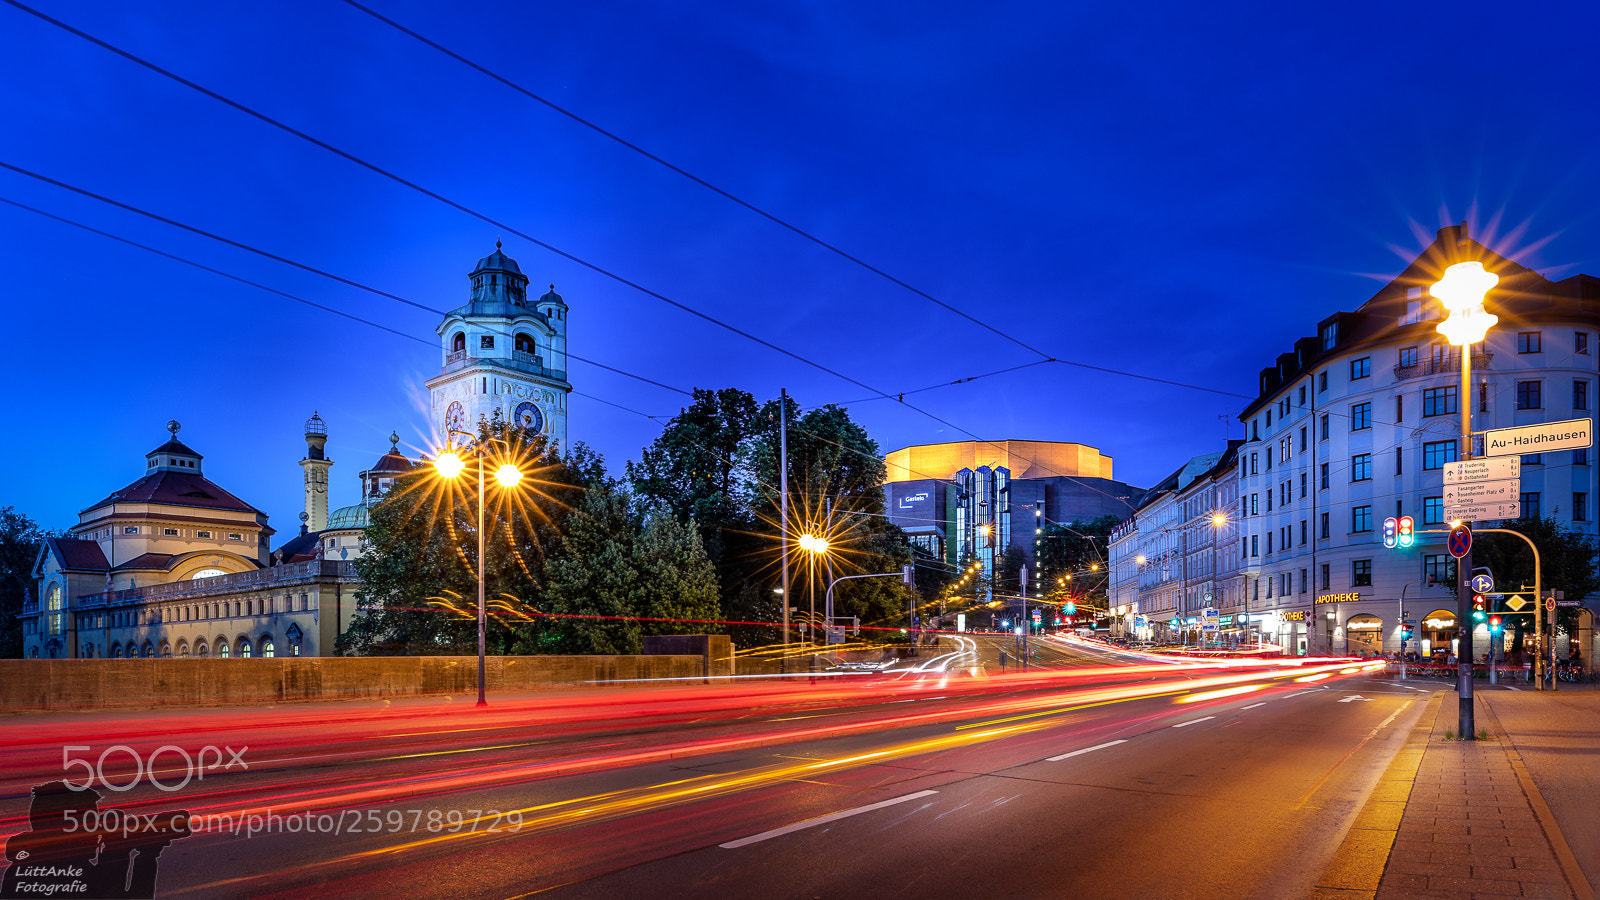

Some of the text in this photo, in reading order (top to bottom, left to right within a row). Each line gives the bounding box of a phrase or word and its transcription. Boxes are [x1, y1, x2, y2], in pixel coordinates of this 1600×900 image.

[1490, 431, 1586, 449] Au-Haidhausen
[1318, 592, 1359, 604] APOTHEKE
[1280, 611, 1304, 621] OTHEKE
